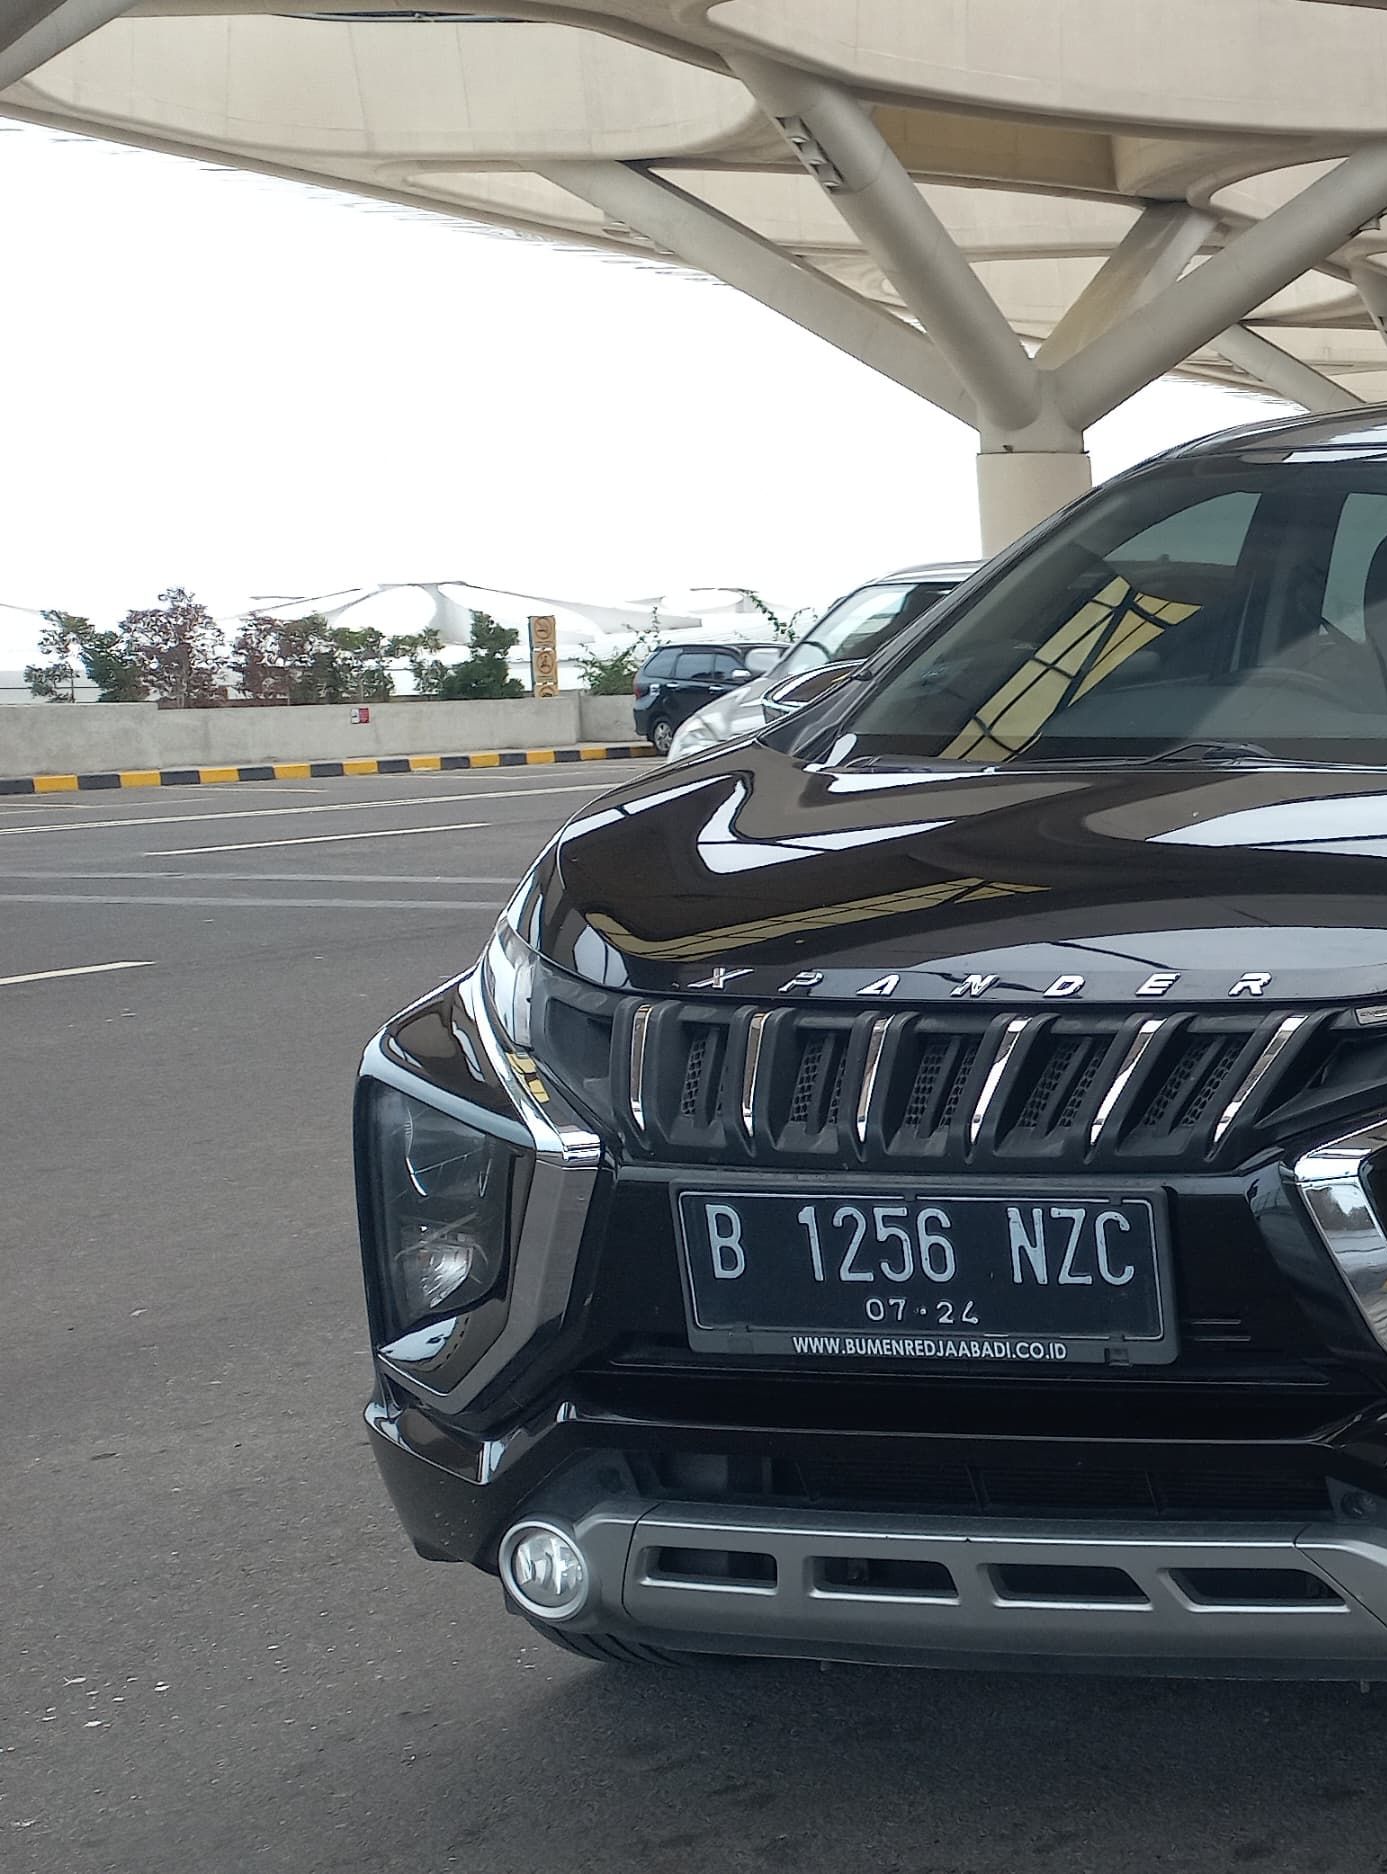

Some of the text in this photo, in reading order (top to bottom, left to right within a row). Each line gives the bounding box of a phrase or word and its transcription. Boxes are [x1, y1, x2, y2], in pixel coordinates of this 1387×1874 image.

[687, 966, 1276, 999] XPANDER
[705, 1203, 1136, 1287] B 1256 NZC
[792, 1335, 1068, 1362] WWW.BUMENREDJAABADI.CO.ID
